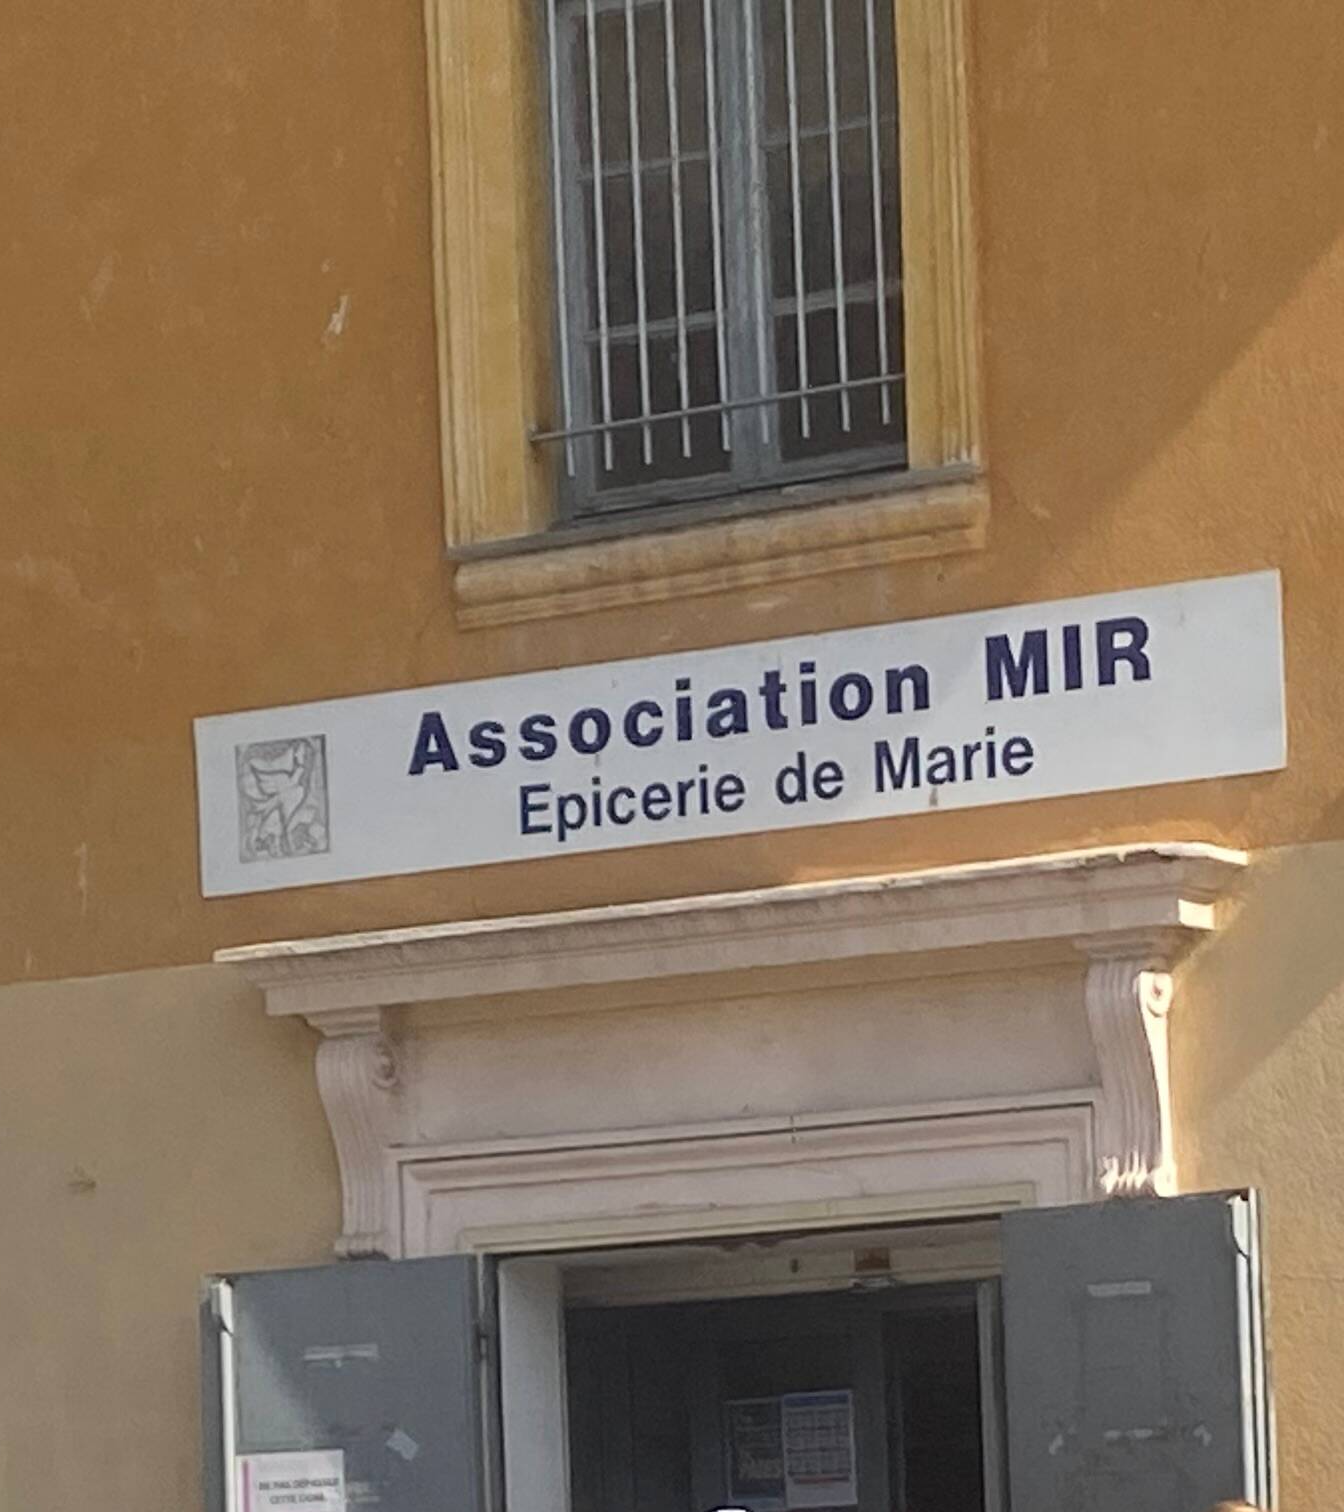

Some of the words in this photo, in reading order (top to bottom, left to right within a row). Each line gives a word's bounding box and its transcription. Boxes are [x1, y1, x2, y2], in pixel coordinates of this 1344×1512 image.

[408, 661, 932, 775] Association
[984, 615, 1152, 702] MIR
[519, 763, 746, 842] Epicerie
[775, 752, 845, 804] de
[873, 726, 1036, 793] Marie
